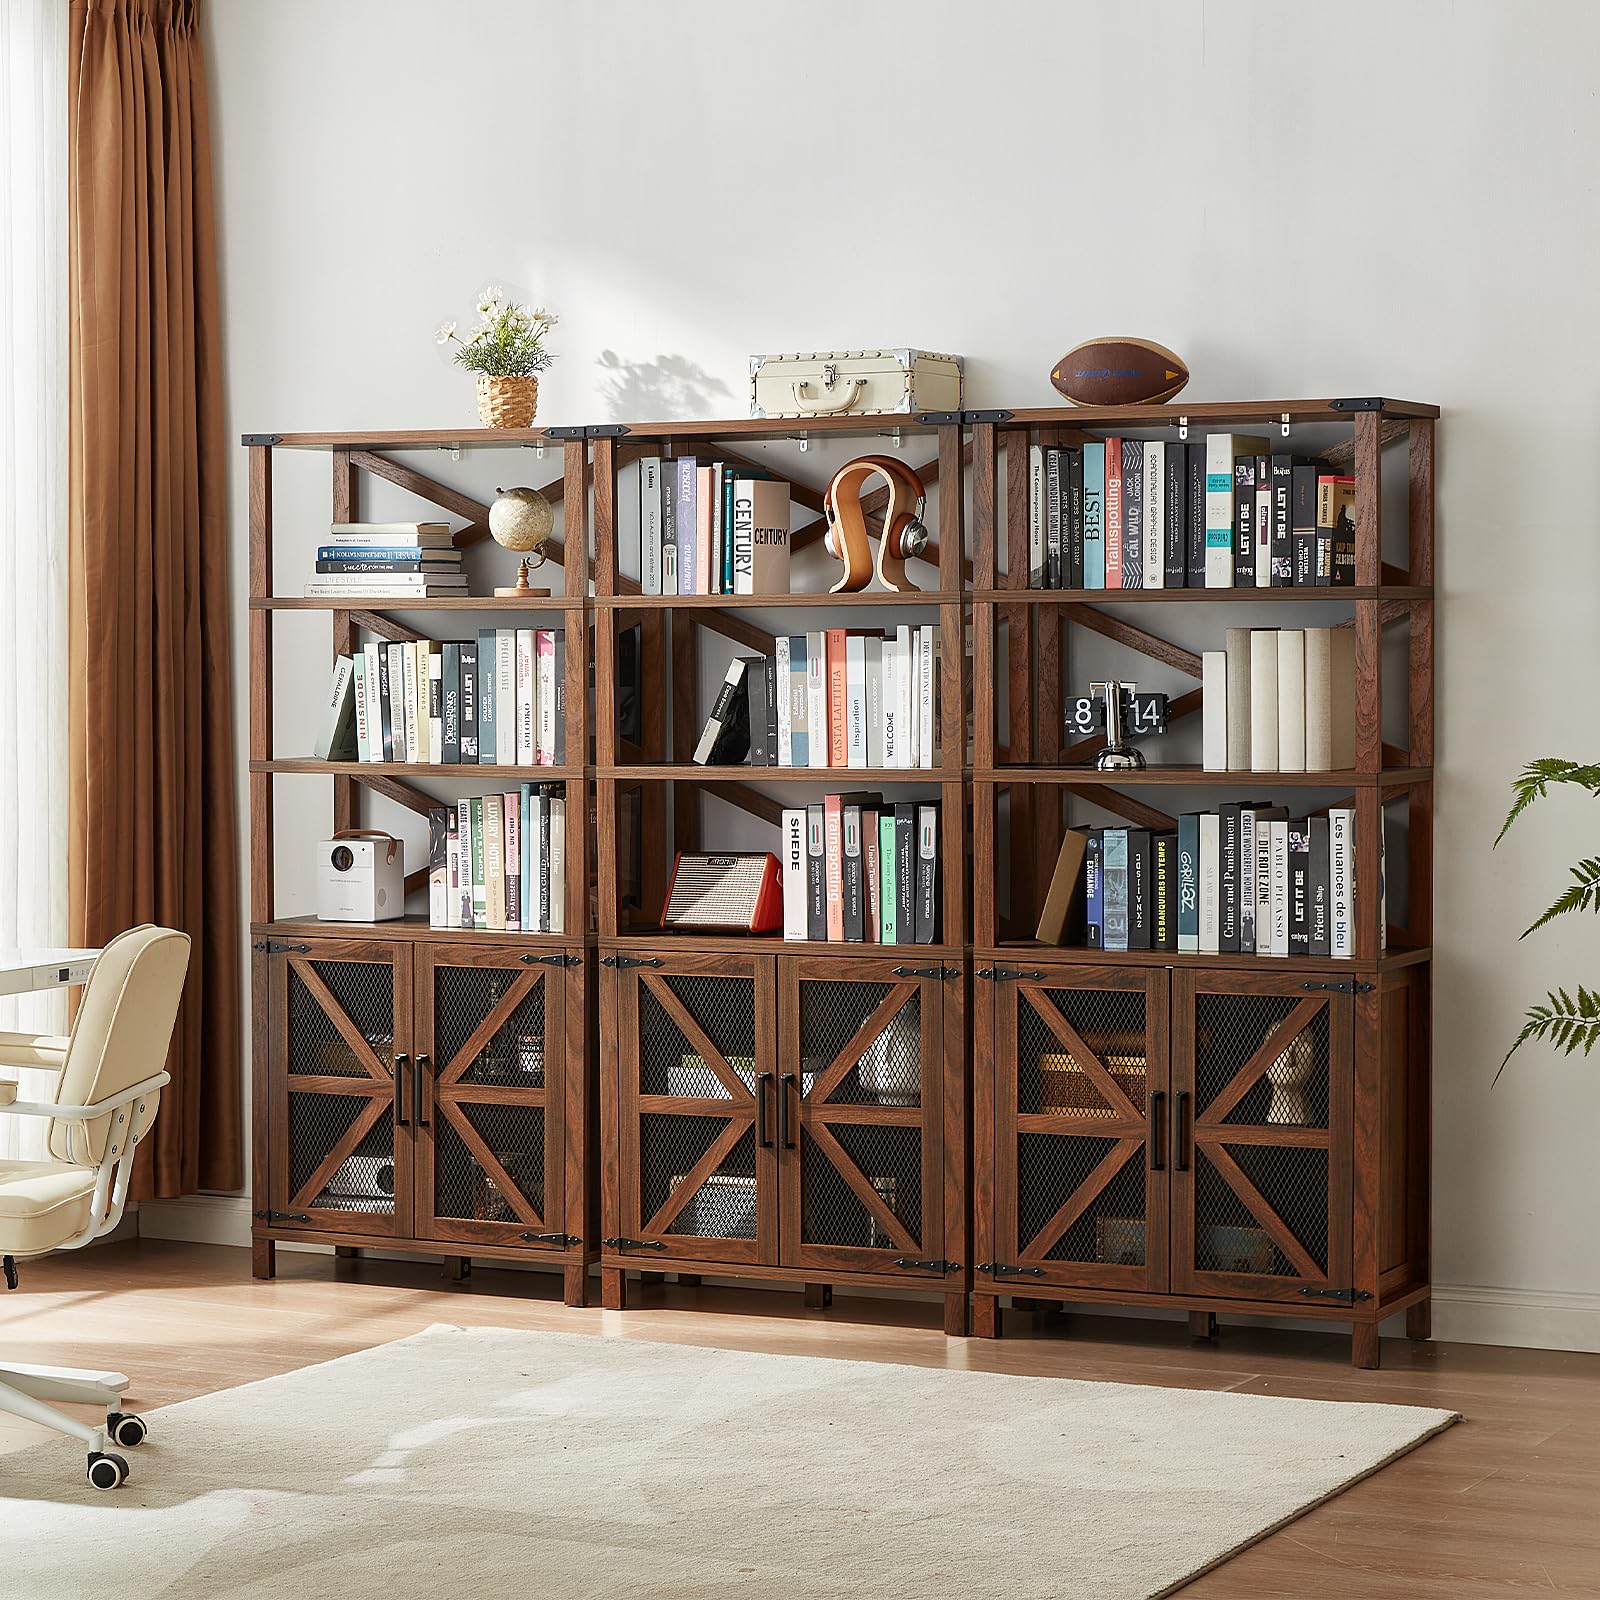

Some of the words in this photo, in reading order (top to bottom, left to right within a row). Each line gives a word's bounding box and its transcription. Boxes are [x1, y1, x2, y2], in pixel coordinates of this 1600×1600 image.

[1048, 454, 1057, 475] CREATE
[1049, 476, 1058, 514] WONDERFUL
[1277, 488, 1285, 507] LET
[1085, 488, 1100, 541] BEST
[1240, 504, 1249, 520] BE
[1277, 510, 1285, 522] IT
[735, 499, 751, 576] CENTURY
[754, 528, 788, 545] CENTURY
[1050, 515, 1058, 544] HOMELIFE
[1241, 522, 1249, 533] IT
[1277, 523, 1285, 539] BE
[1241, 534, 1249, 555] LET
[390, 649, 398, 668] CREATE
[331, 667, 346, 709] GERALDINE
[391, 670, 400, 702] WONDERFUL
[501, 671, 509, 691] ISSUE
[357, 675, 366, 739] NINSMODE
[465, 692, 472, 706] IT
[833, 670, 841, 721] LAETITIA
[394, 704, 402, 731] HOMELIFE
[465, 707, 472, 721] BE
[1075, 699, 1092, 724] 8
[1129, 700, 1159, 726] 14
[834, 724, 842, 761] CASTA
[460, 803, 468, 823] CREATE
[487, 802, 499, 838] LUXURY
[1243, 814, 1251, 836] CREATE
[1335, 816, 1346, 839] Les
[461, 824, 469, 858] WONDERFUL
[509, 835, 514, 846] UN
[791, 818, 800, 871] SHEDE
[1223, 816, 1235, 882] Punishment
[1259, 840, 1268, 854] DIE
[489, 843, 499, 878] HOTELS
[1259, 857, 1269, 880] ROTE
[1275, 837, 1283, 878] PABLO
[1159, 869, 1165, 880] DU
[1295, 870, 1303, 886] BE
[1335, 843, 1346, 897] nuances
[1224, 884, 1234, 906] and
[1244, 877, 1252, 907] HOMELIFE
[1259, 882, 1269, 905] ZONE
[1295, 888, 1303, 900] IT
[510, 912, 515, 920] LA
[1275, 886, 1283, 938] PICASSO
[1295, 901, 1303, 922] LET
[1336, 902, 1346, 918] de
[1224, 909, 1233, 938] Crime
[1314, 904, 1324, 941] Friend
[1336, 921, 1346, 949] bleu
